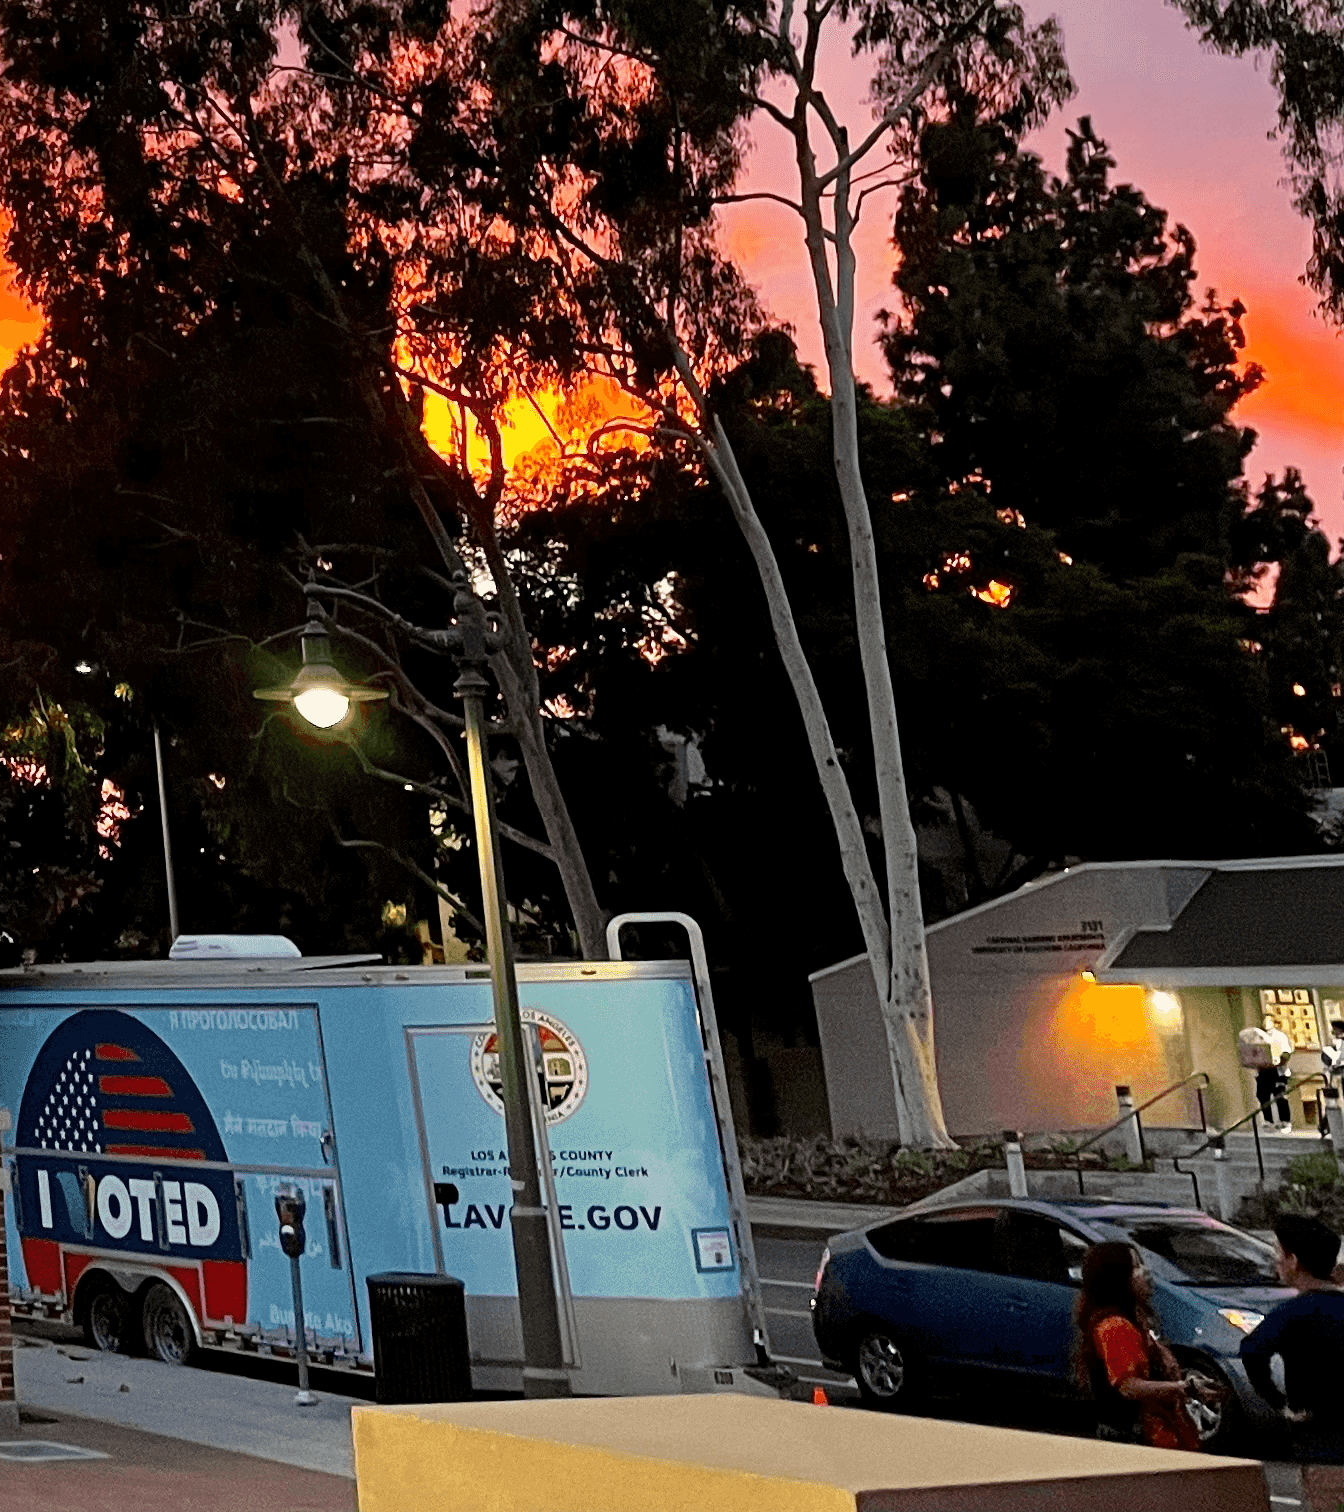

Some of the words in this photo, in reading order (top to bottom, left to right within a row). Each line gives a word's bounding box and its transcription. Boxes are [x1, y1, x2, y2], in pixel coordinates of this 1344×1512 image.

[471, 1150, 495, 1161] LOS
[559, 1150, 613, 1161] COUNTY
[614, 1166, 649, 1178] Clerk
[37, 1169, 53, 1229] I
[443, 1204, 662, 1231] LAVE.GOV
